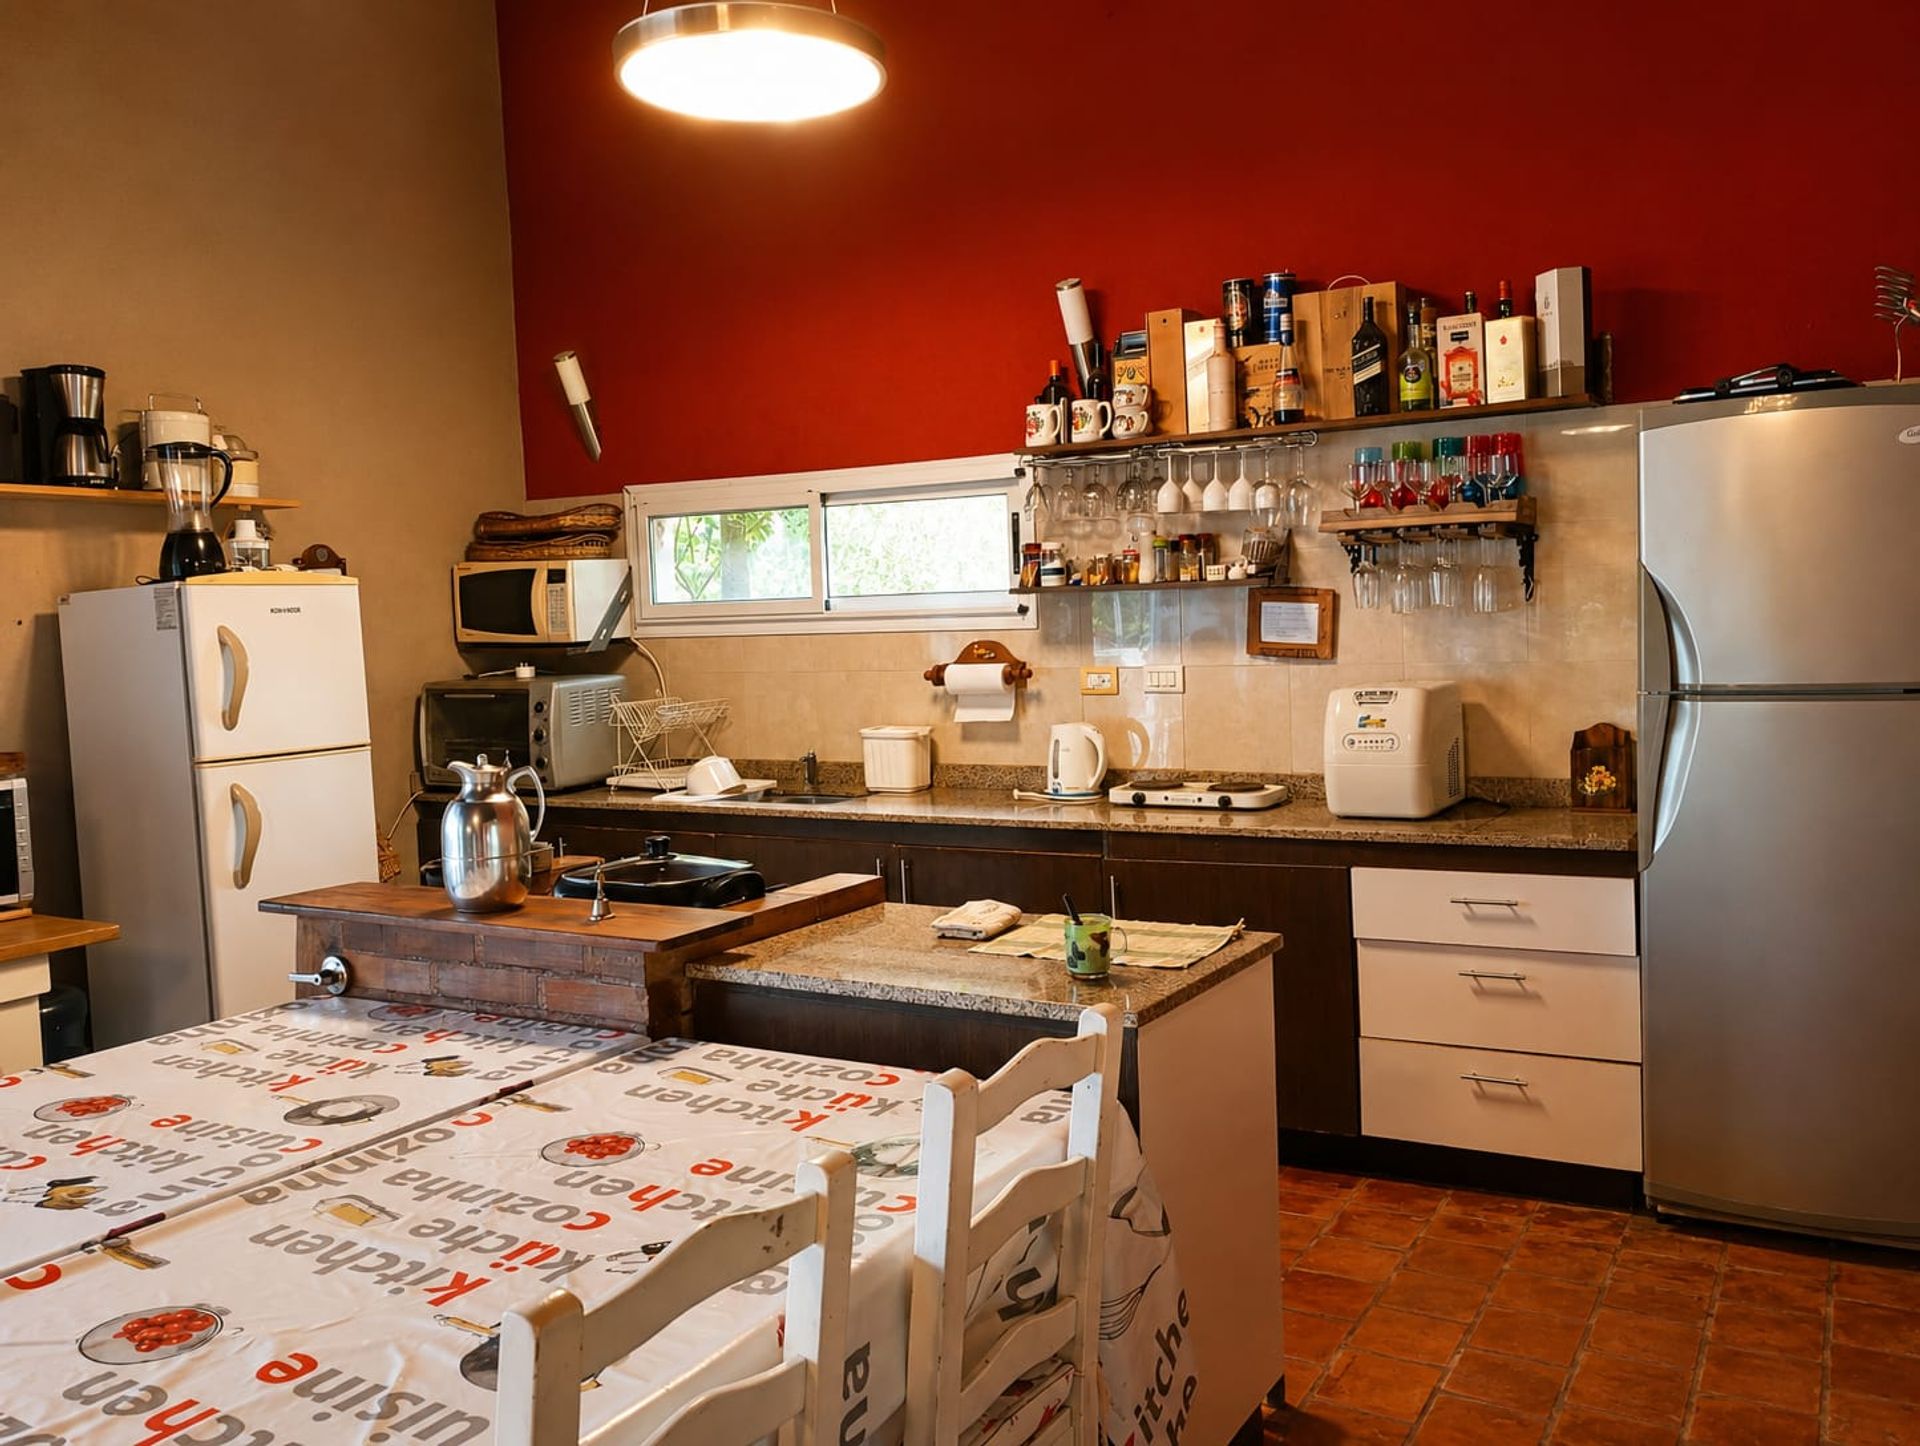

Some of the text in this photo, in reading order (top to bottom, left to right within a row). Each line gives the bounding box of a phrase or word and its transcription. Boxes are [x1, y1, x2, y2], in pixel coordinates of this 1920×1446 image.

[148, 1001, 309, 1046] ozinha
[253, 1023, 408, 1055] cozinha
[373, 1022, 536, 1054] kitchen
[152, 1053, 316, 1093] kitchen
[265, 1049, 388, 1079] küche
[701, 1048, 901, 1087] cozinha
[624, 1083, 831, 1132] kitchen
[746, 1079, 900, 1117] küche
[22, 1124, 204, 1174] kitchen
[150, 1114, 323, 1154] cuisine
[382, 1168, 612, 1232] cozinha
[554, 1170, 760, 1221] tchen
[249, 1223, 492, 1308] kitchen
[408, 1218, 596, 1284] küche
[255, 1352, 491, 1443] uisine
